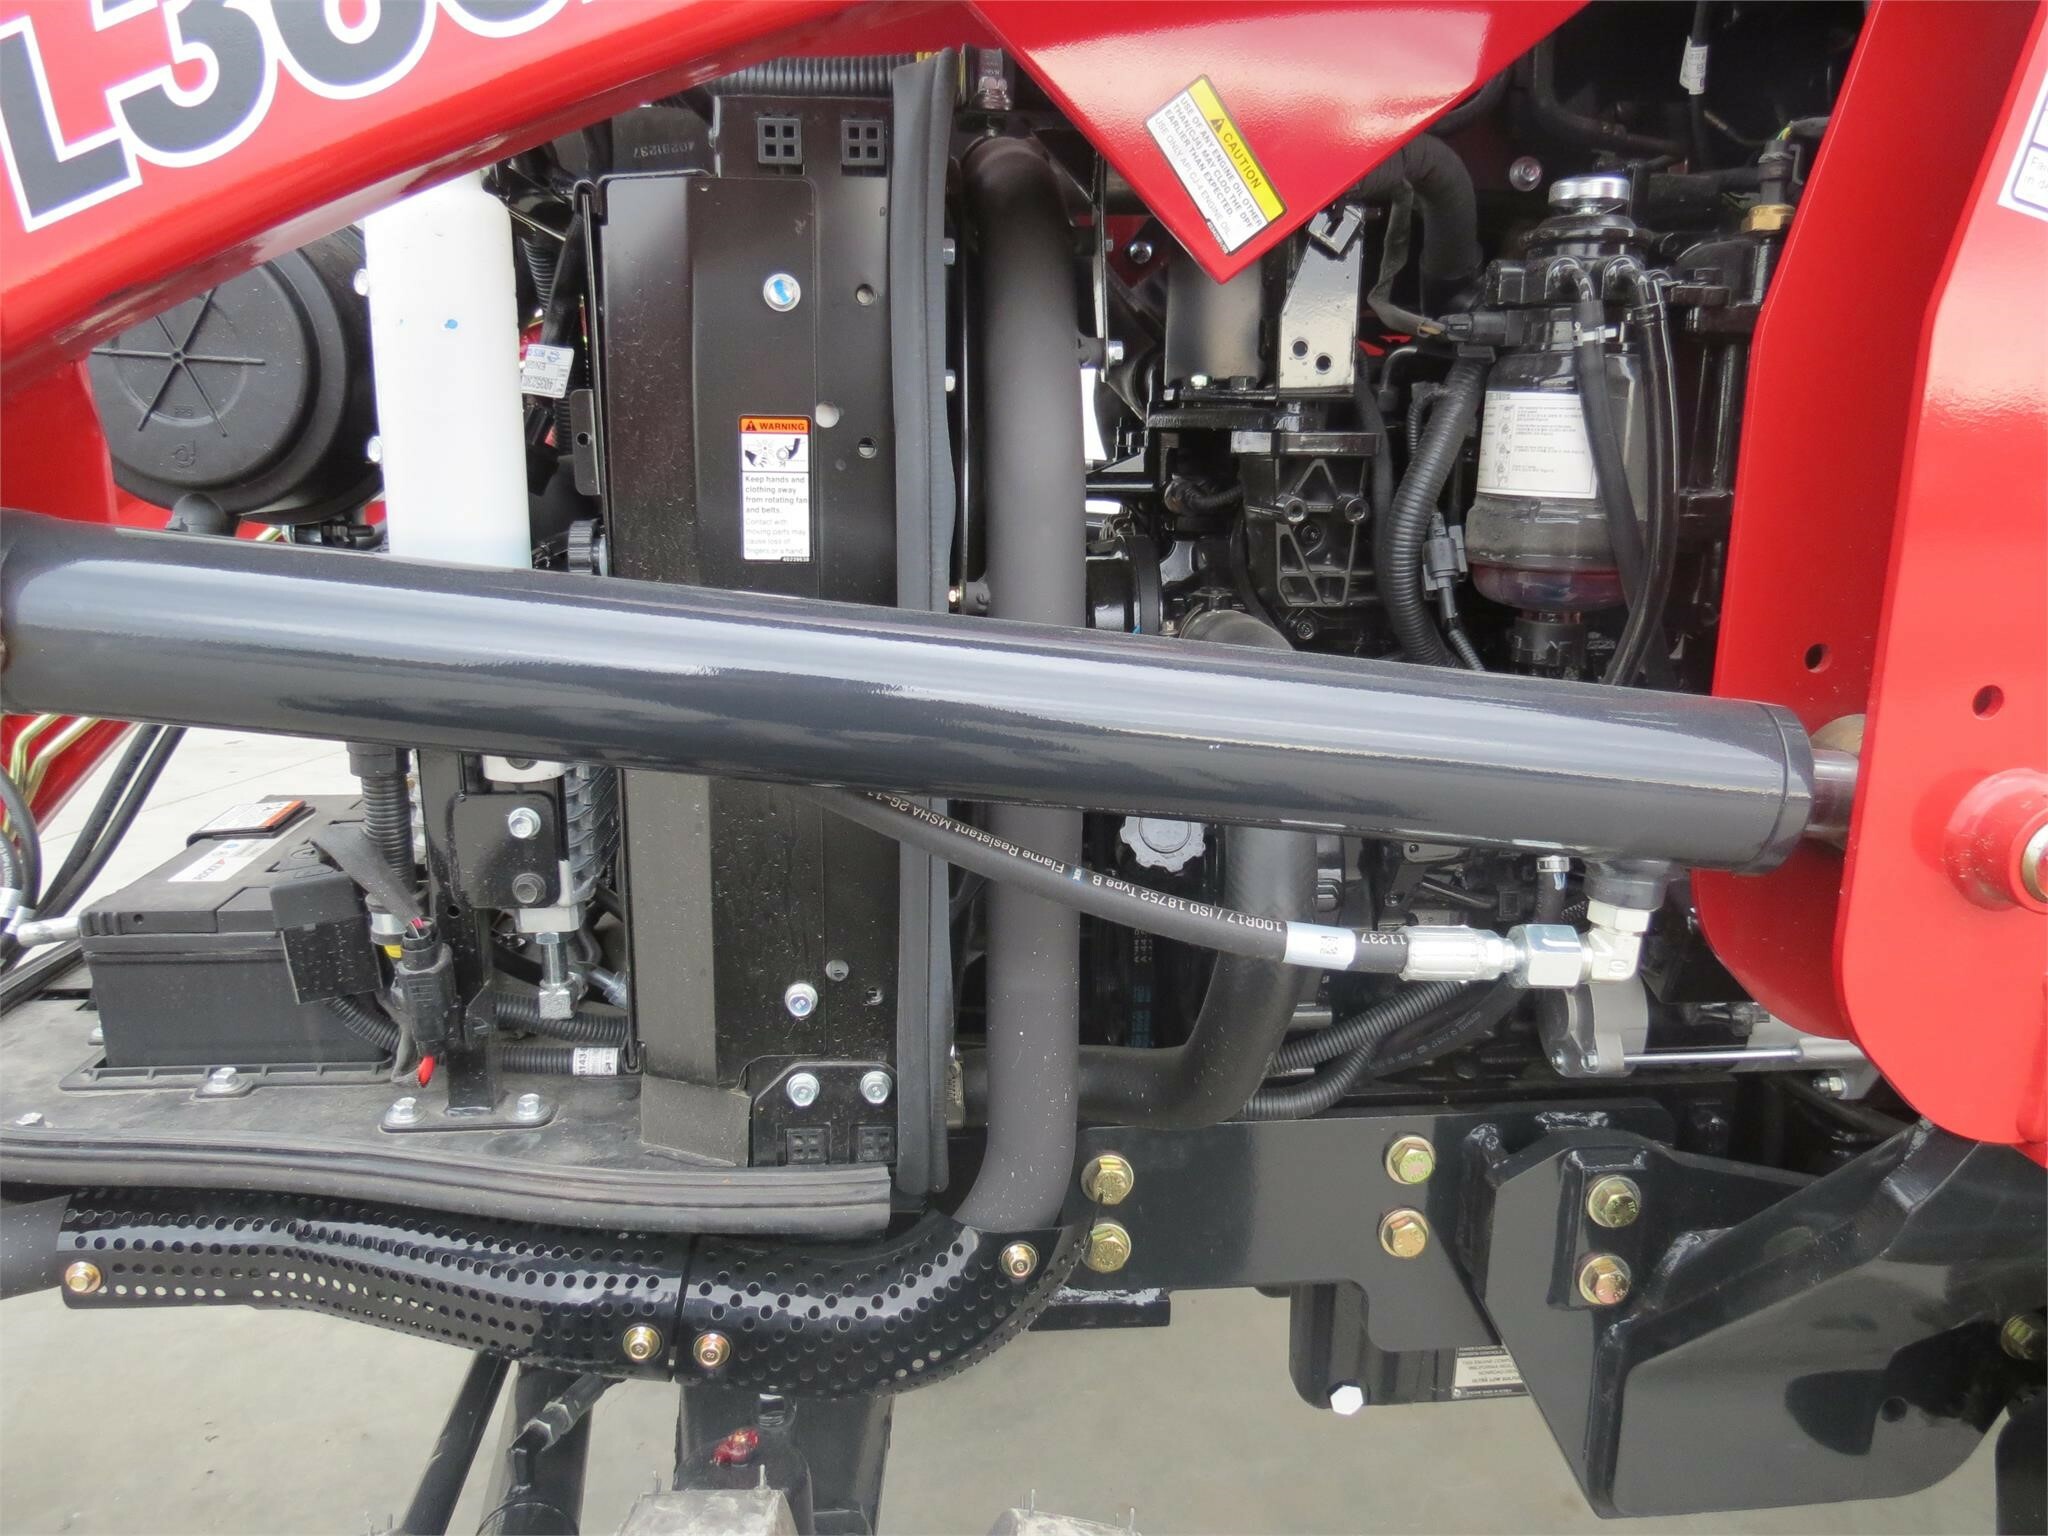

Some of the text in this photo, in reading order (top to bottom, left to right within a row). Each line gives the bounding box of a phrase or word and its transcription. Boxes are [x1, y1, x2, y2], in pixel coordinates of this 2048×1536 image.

[1165, 110, 1191, 147] EARLIER
[1188, 146, 1207, 172] THAN
[1180, 97, 1263, 226] USE OF ANY ENGINE OIL OTHER
[1223, 132, 1261, 189] CAUTION
[1201, 149, 1215, 170] MAY
[1228, 194, 1242, 212] THE
[760, 422, 805, 431] WARNING
[745, 476, 764, 484] Keep
[745, 486, 796, 495] clothing away
[745, 496, 808, 505] from rotating fan
[745, 518, 773, 526] Contact
[912, 806, 951, 831] MSHA
[954, 824, 1020, 858] Resistant
[1022, 850, 1066, 875] Flame
[1092, 874, 1102, 887] B
[1105, 877, 1138, 899] Type
[1140, 890, 1185, 910] 18752
[1189, 903, 1214, 919] ISO
[1227, 912, 1283, 933] 100R17
